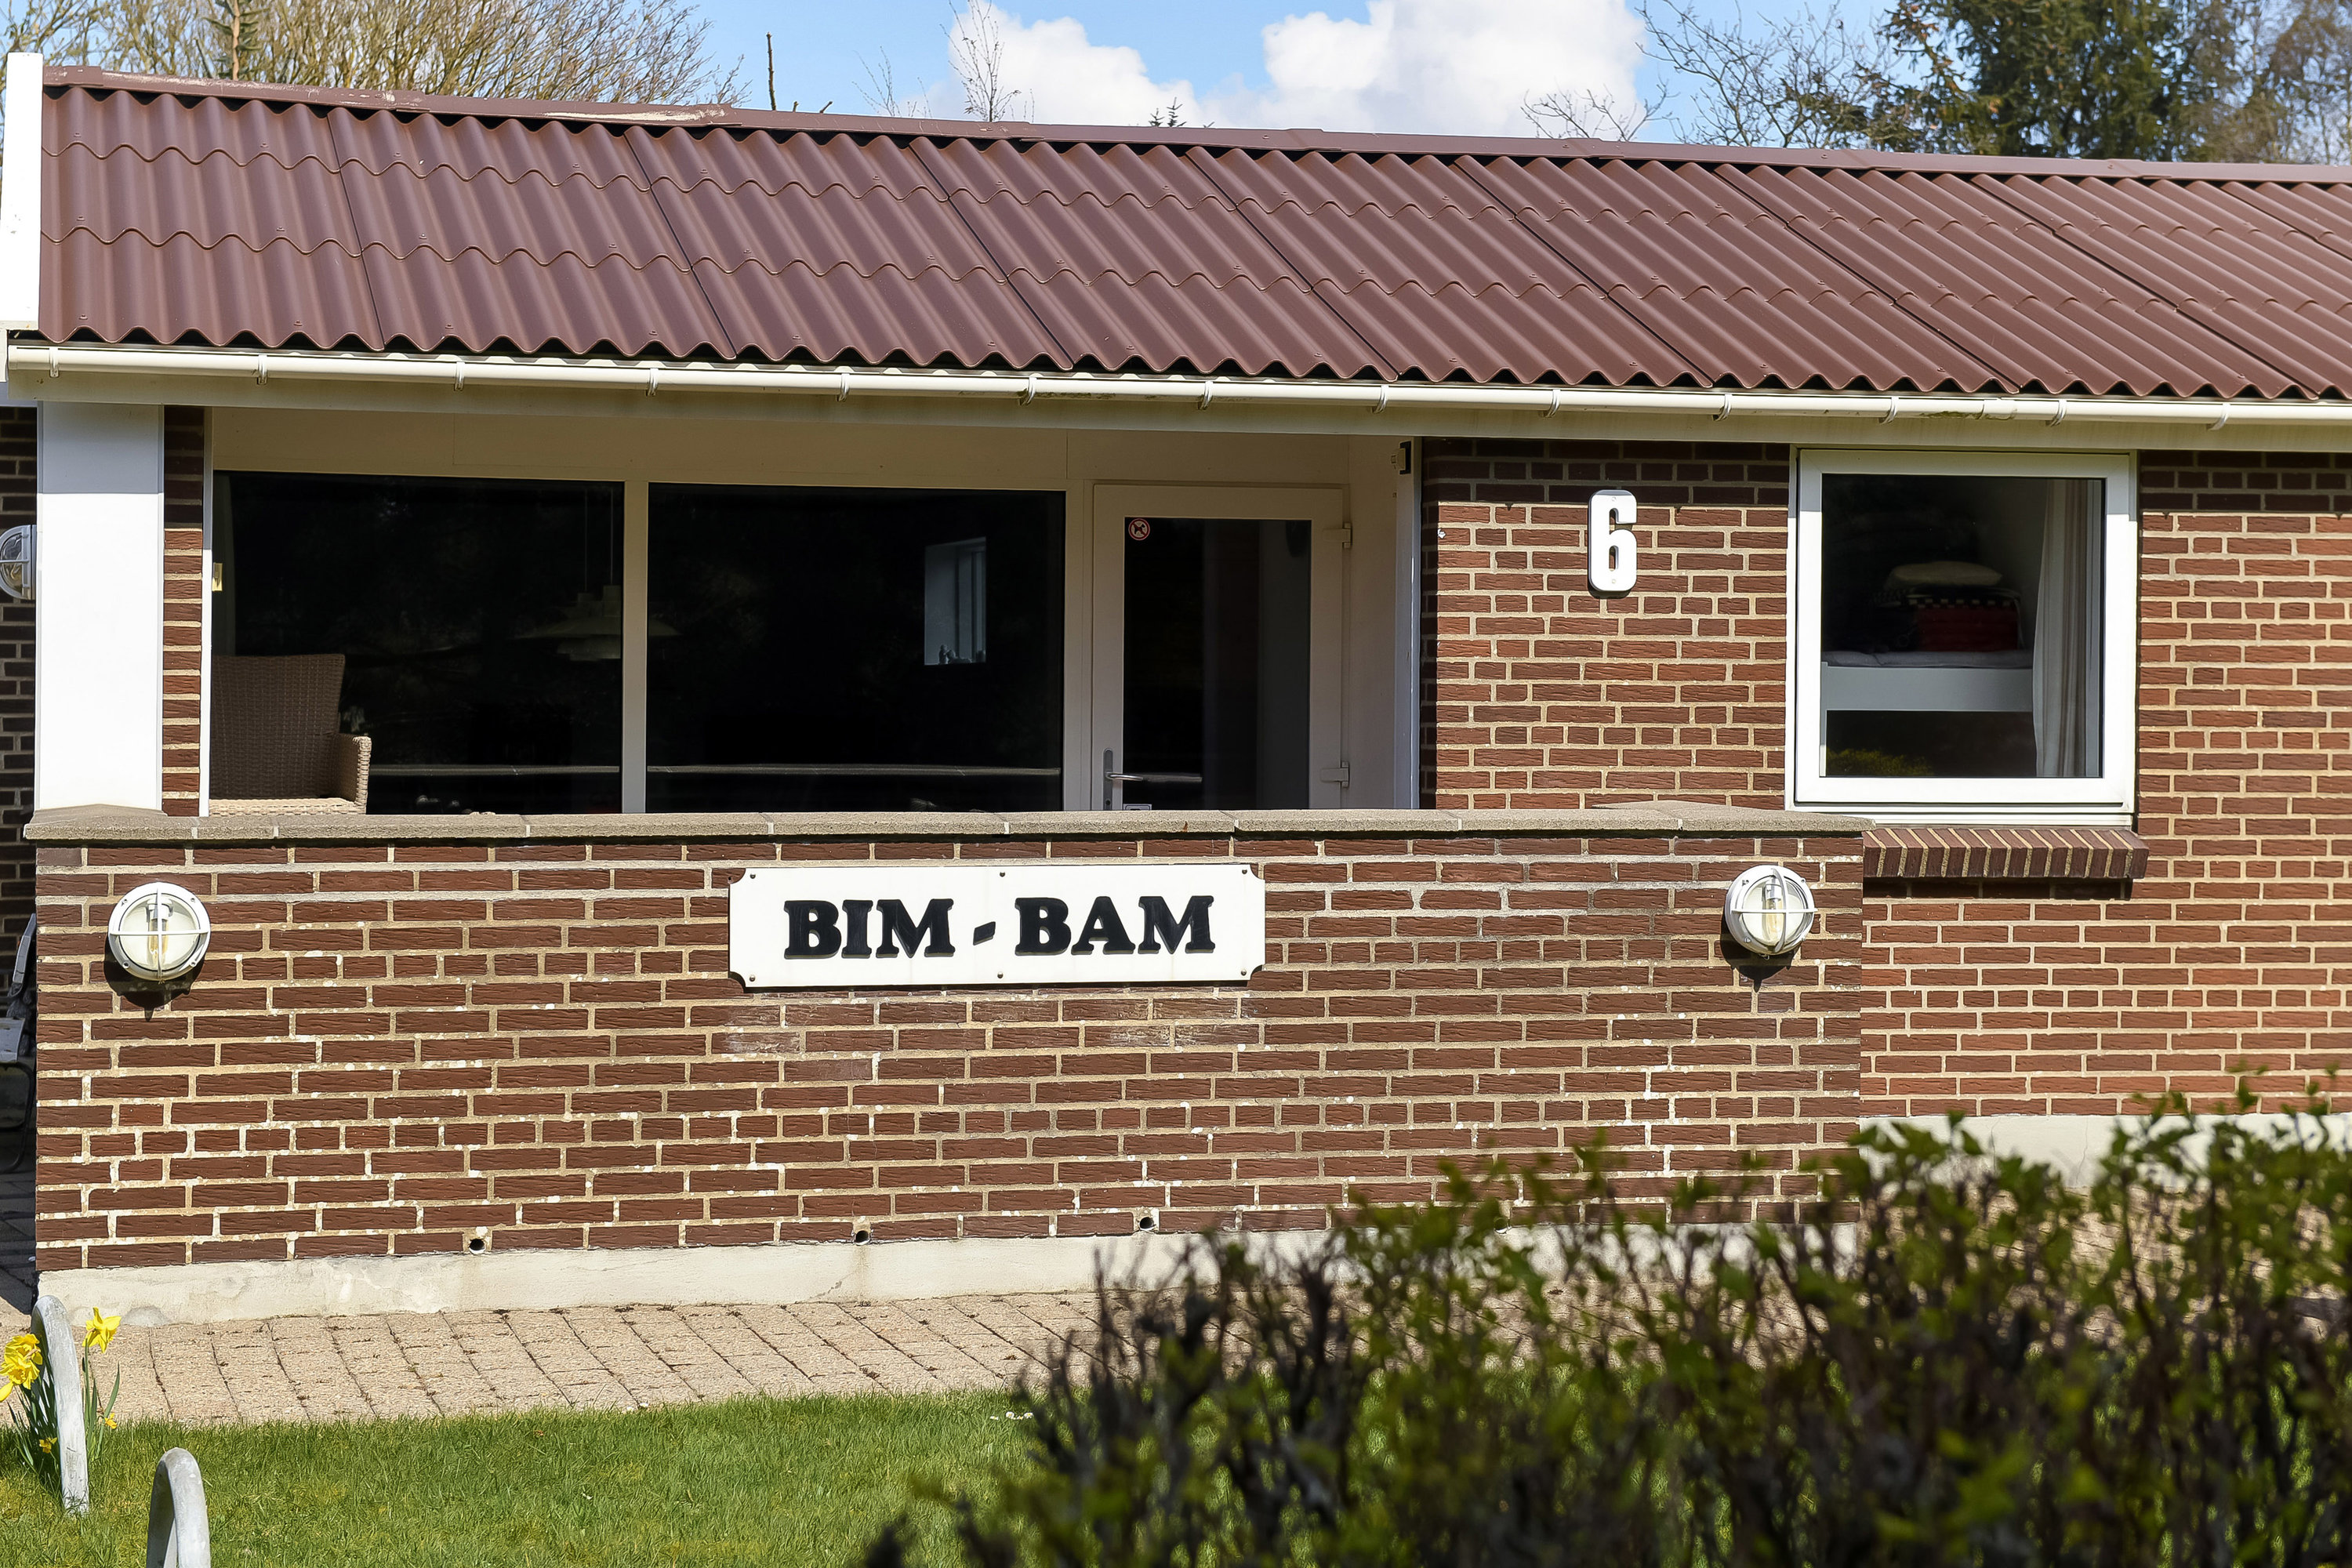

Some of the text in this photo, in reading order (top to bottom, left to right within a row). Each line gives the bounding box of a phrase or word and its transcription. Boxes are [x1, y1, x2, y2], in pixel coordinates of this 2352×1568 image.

[1588, 489, 1637, 592] 6
[783, 898, 955, 959] BIM
[1014, 895, 1216, 956] BAM
